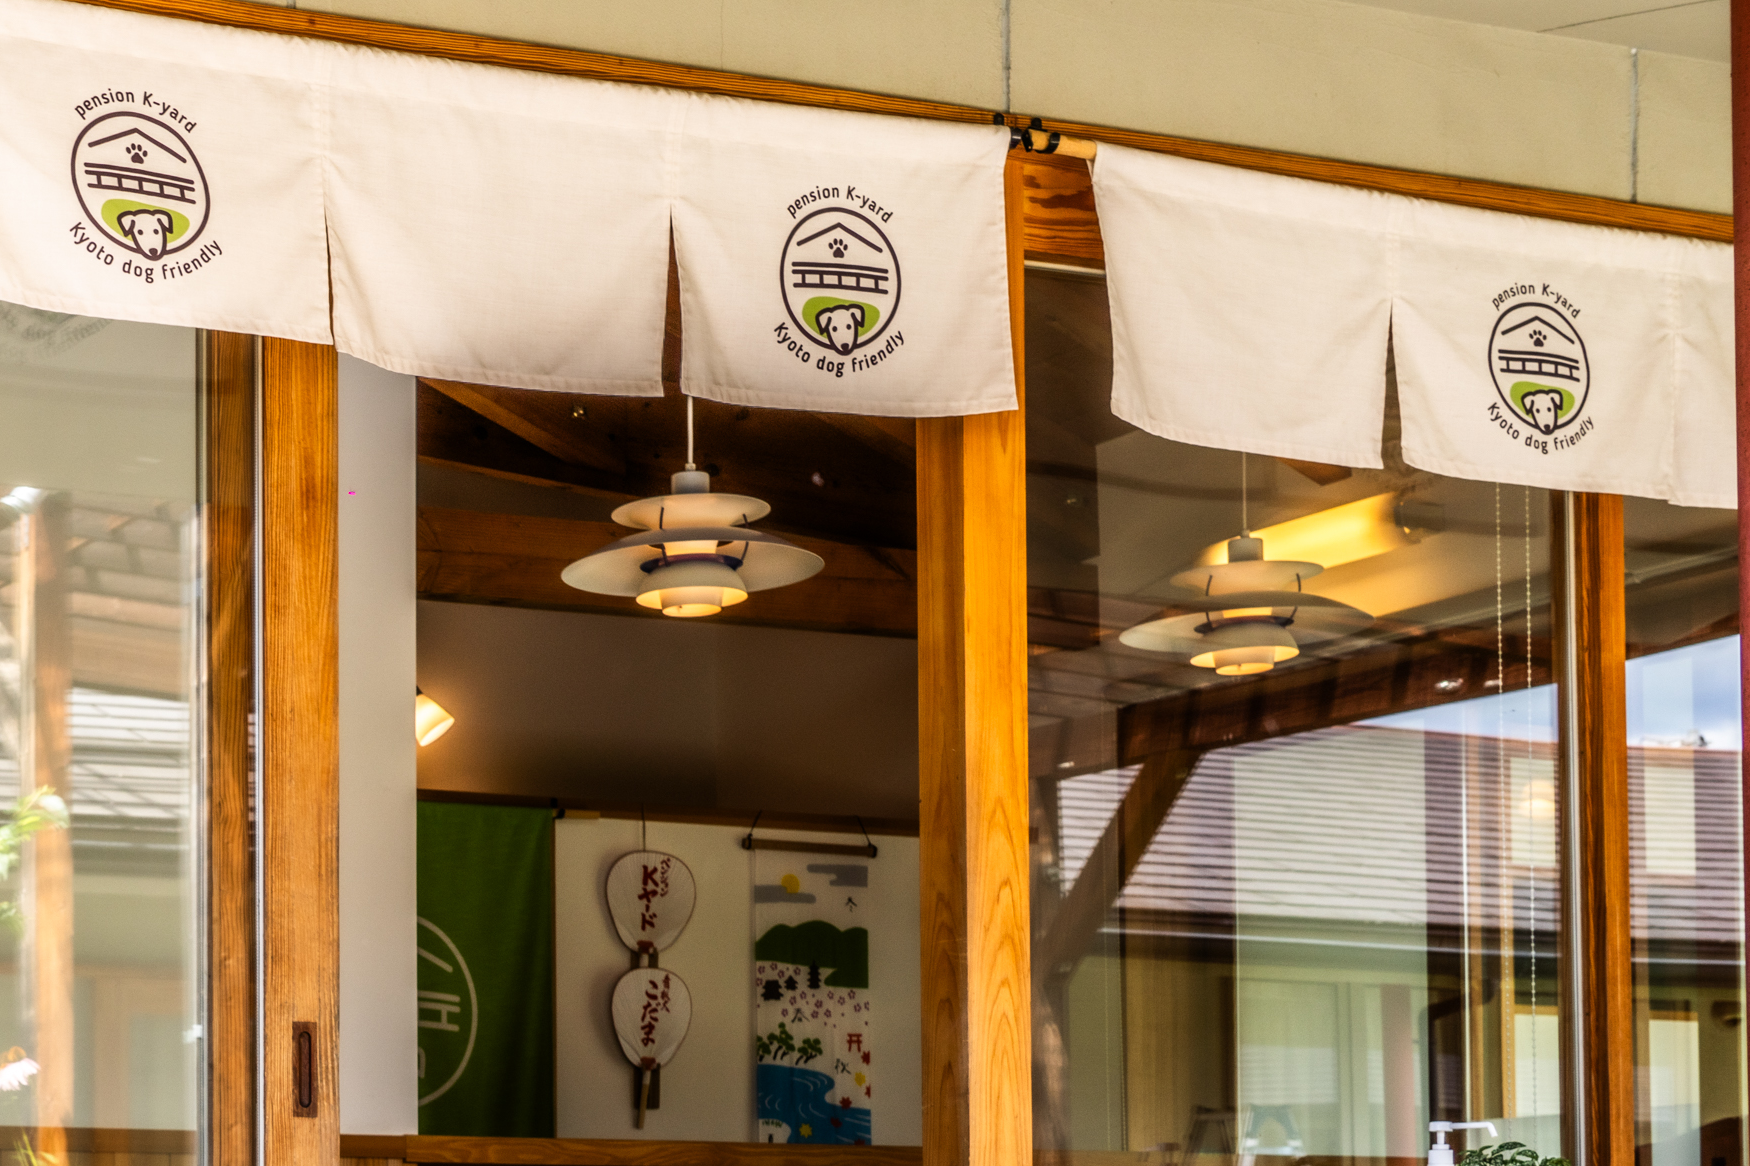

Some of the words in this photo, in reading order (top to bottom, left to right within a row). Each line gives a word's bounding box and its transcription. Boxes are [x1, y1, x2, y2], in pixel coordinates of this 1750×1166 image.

[74, 88, 135, 120] pension
[142, 91, 197, 133] K-yard
[786, 185, 840, 219] pension
[846, 185, 894, 223] K-yard
[69, 221, 114, 265] Kyoto
[122, 259, 155, 284] dog
[161, 240, 223, 279] friendly
[1492, 282, 1535, 311] pension
[1541, 283, 1581, 319] K-yard
[773, 322, 811, 363] Kyoto
[816, 355, 845, 378] dog
[851, 330, 905, 373] friendly
[1487, 401, 1520, 440] Kyoto
[1524, 434, 1549, 455] dog
[1553, 415, 1595, 451] friendly
[637, 864, 659, 932] Kヤード
[641, 979, 661, 1047] こだま
